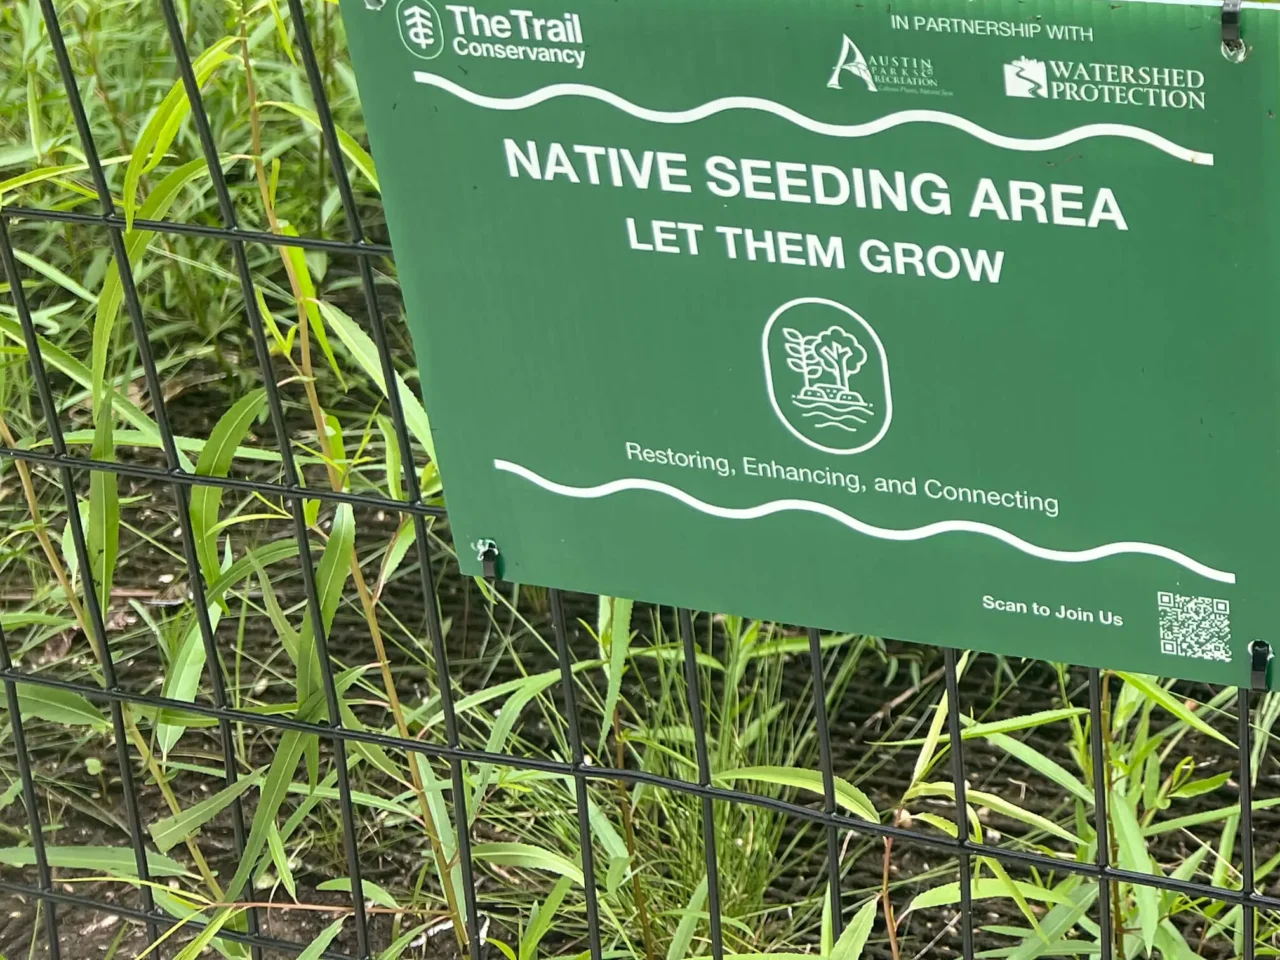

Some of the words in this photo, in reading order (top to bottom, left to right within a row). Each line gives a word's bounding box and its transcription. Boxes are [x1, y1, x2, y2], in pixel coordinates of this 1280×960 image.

[446, 5, 512, 39] The
[509, 10, 582, 43] Trail
[890, 14, 909, 30] IN
[914, 15, 1041, 37] PARTNERSHIP
[1046, 25, 1093, 41] WITH
[453, 36, 585, 69] Conservancy
[868, 54, 932, 69] AUSTIN
[874, 74, 939, 87] RECREATION
[1050, 61, 1204, 90] WATERSHED
[1052, 82, 1204, 109] PROTECTION
[504, 139, 691, 192] NATIVE
[706, 156, 951, 215] SEEDING
[969, 178, 1128, 230] AREA
[626, 218, 703, 255] LET
[716, 226, 845, 268] THEM
[860, 239, 1004, 283] GROW
[624, 442, 735, 480] Restoring,
[743, 457, 866, 493] Enhancing,
[875, 478, 916, 495] and
[924, 479, 1058, 517] Connecting
[983, 596, 1027, 613] Scan
[1030, 601, 1052, 617] to
[1056, 605, 1093, 622] Join
[1099, 611, 1123, 626] Us
